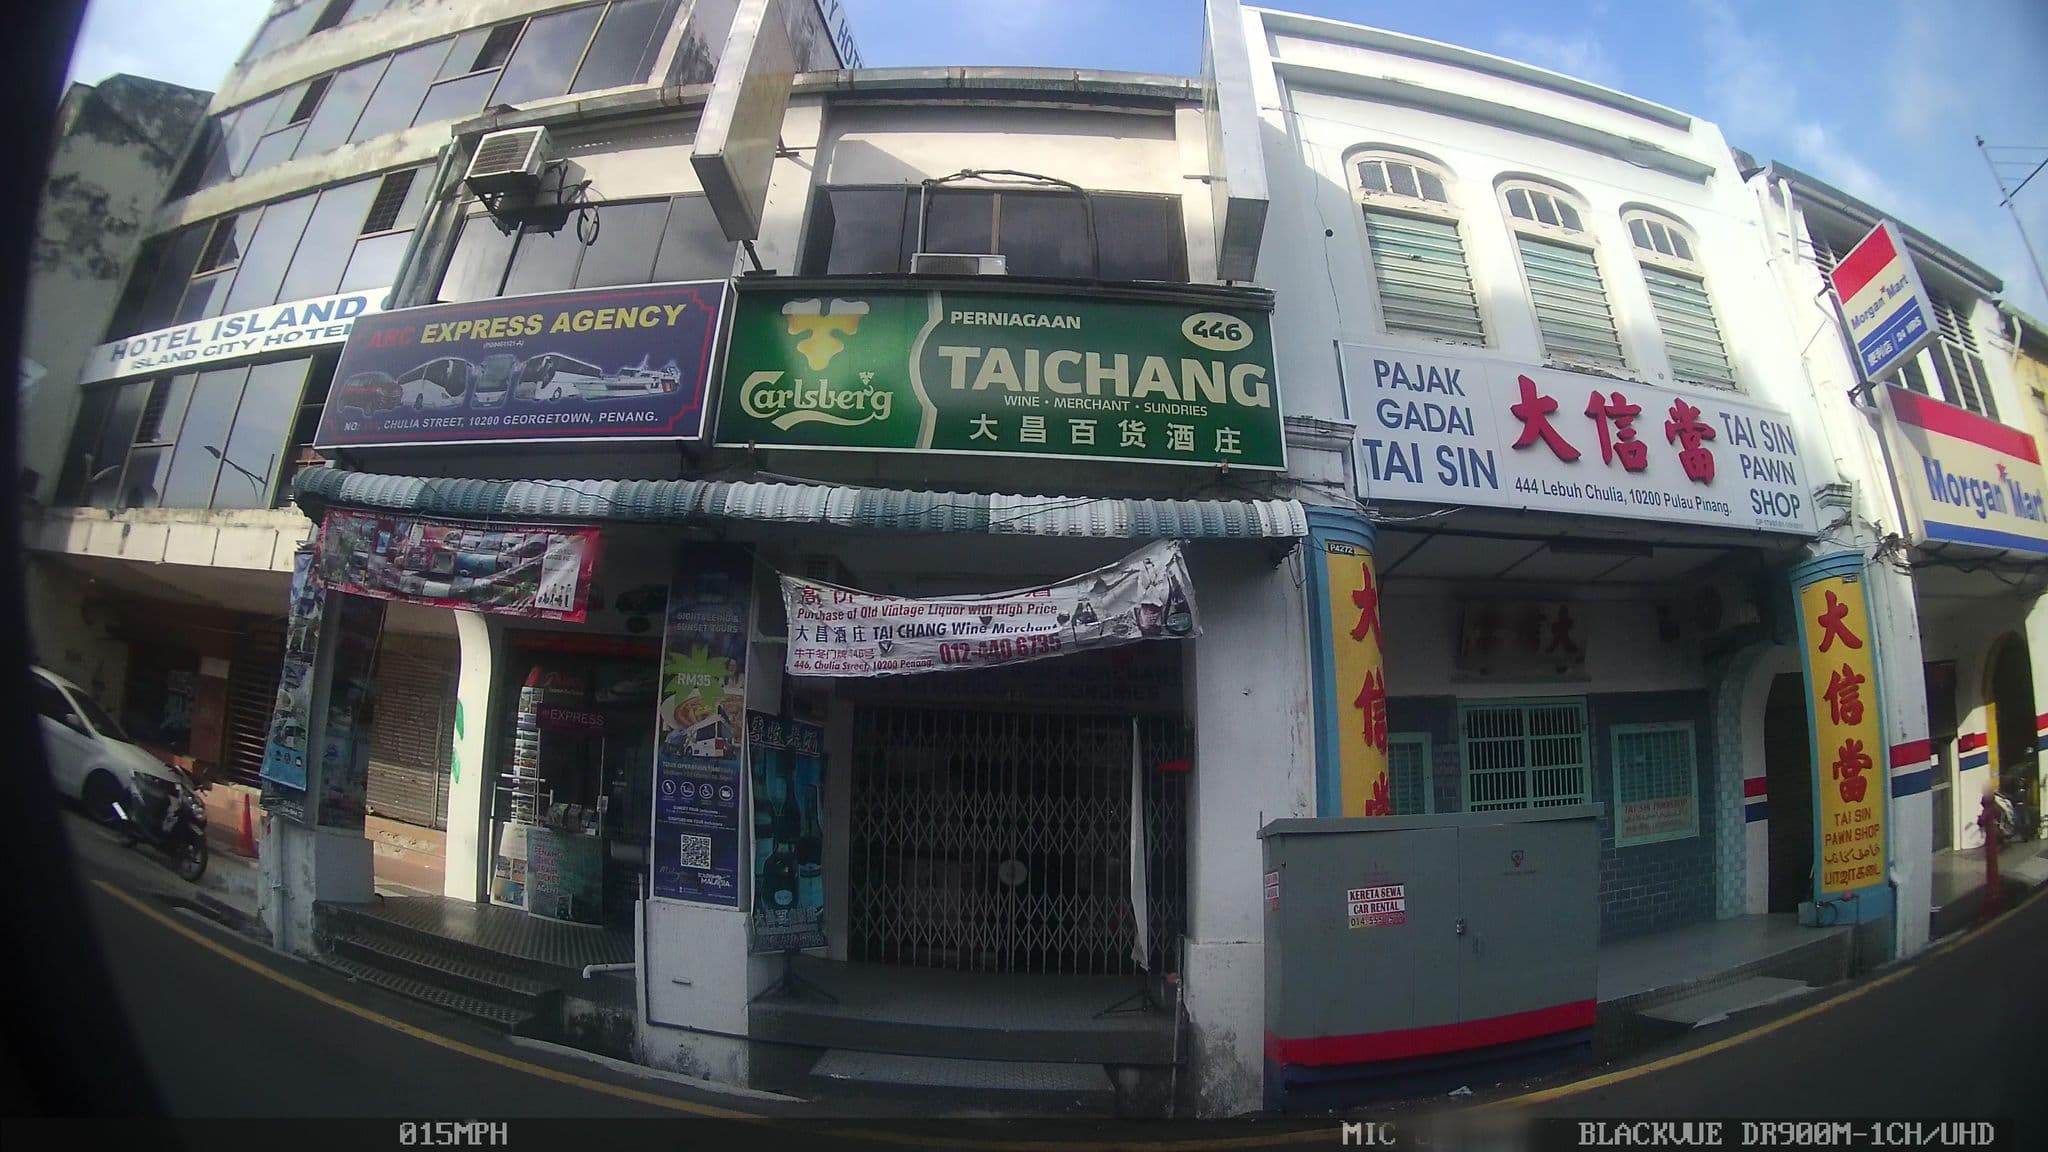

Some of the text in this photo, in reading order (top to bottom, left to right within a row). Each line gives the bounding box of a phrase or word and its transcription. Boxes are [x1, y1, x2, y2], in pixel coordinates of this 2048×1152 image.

[837, 18, 863, 69] HOT
[1850, 273, 1909, 330] Morgan Mart
[111, 295, 367, 362] HOTEL ISLAND
[420, 314, 543, 344] EXPRESS
[549, 304, 686, 335] AGENCY
[950, 310, 1081, 330] PERNIAGAAN
[1192, 319, 1242, 342] 446
[132, 349, 197, 370] ISLAND
[202, 338, 257, 357] CITY
[938, 345, 1271, 408] TAICHANG
[1374, 359, 1465, 397] PAJAK
[740, 369, 894, 423] Carlsberg
[1003, 394, 1208, 417] WINE MERCHANT SUNDRIES
[384, 418, 420, 430] CHULIA
[422, 416, 466, 428] STREET,
[469, 415, 499, 427] 10200
[503, 412, 594, 425] GEORGETOWN,
[599, 411, 658, 423] PENANG.
[1376, 399, 1475, 437] GADAI
[1510, 374, 1717, 486] 大信當
[970, 413, 1242, 455] 大昌百货酒庄
[1720, 411, 1797, 457] TAI SIN
[1362, 438, 1499, 490] TAI SIN
[1741, 453, 1797, 486] PAWN
[1515, 476, 1732, 517] 444 Lebuh Chulia, 10200 Pulau Pinang.
[1921, 456, 2008, 519] Morgan
[1751, 489, 1800, 519] SHOP
[1330, 544, 1355, 554] P4272
[797, 607, 844, 621] Purchase
[847, 606, 858, 620] of
[860, 606, 878, 618] Old
[882, 604, 925, 618] Vintage
[928, 603, 965, 618] Liquor
[968, 603, 993, 616] with
[1027, 603, 1058, 615] Price
[795, 625, 867, 644] 大昌酒庄
[873, 625, 893, 640] TAI
[898, 622, 947, 639] CHANG
[952, 622, 987, 636] Wine
[1016, 632, 1062, 657] 6735
[678, 673, 712, 687] RM35
[814, 659, 841, 670] Chulia
[873, 659, 898, 670] 10200
[1818, 590, 1873, 804] 大信當
[551, 708, 605, 726] EXPRESS
[1834, 807, 1872, 827] TAI SIN
[1824, 823, 1880, 847] PAWN SHOP
[1350, 886, 1402, 901] KERETA SEWA
[1354, 901, 1400, 915] CAR RENTAL
